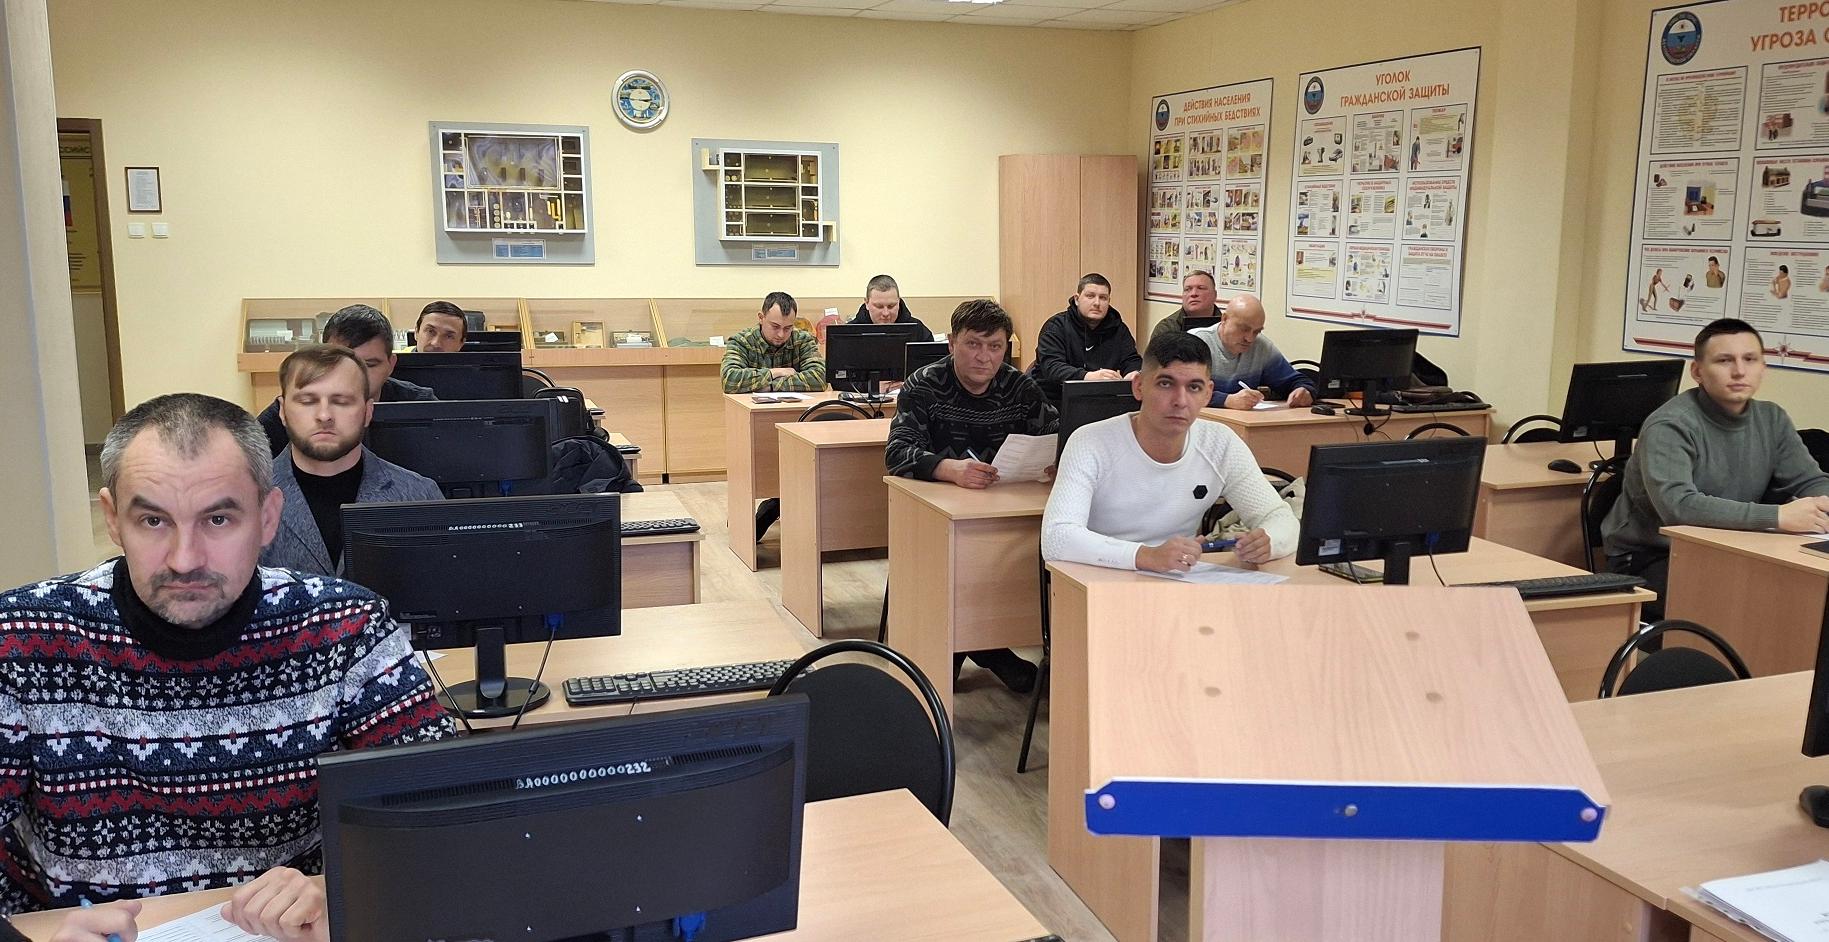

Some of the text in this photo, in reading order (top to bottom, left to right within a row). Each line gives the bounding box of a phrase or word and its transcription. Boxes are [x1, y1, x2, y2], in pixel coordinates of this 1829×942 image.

[1780, 1, 1829, 23] ТЕРРО
[1750, 28, 1817, 52] УГРОЗА
[1375, 70, 1411, 86] УГОЛОК
[1183, 93, 1251, 113] ДЕЙСТВИЯ НАСЕЛЕНИЯ
[1340, 83, 1450, 108] ГРАЖДАНСКОЙ ЗАЩИТЫ
[1174, 117, 1185, 127] ПРИ
[1186, 111, 1223, 126] СТИХИЙНЫХ
[1224, 106, 1261, 121] БЕДСТВИЯХ
